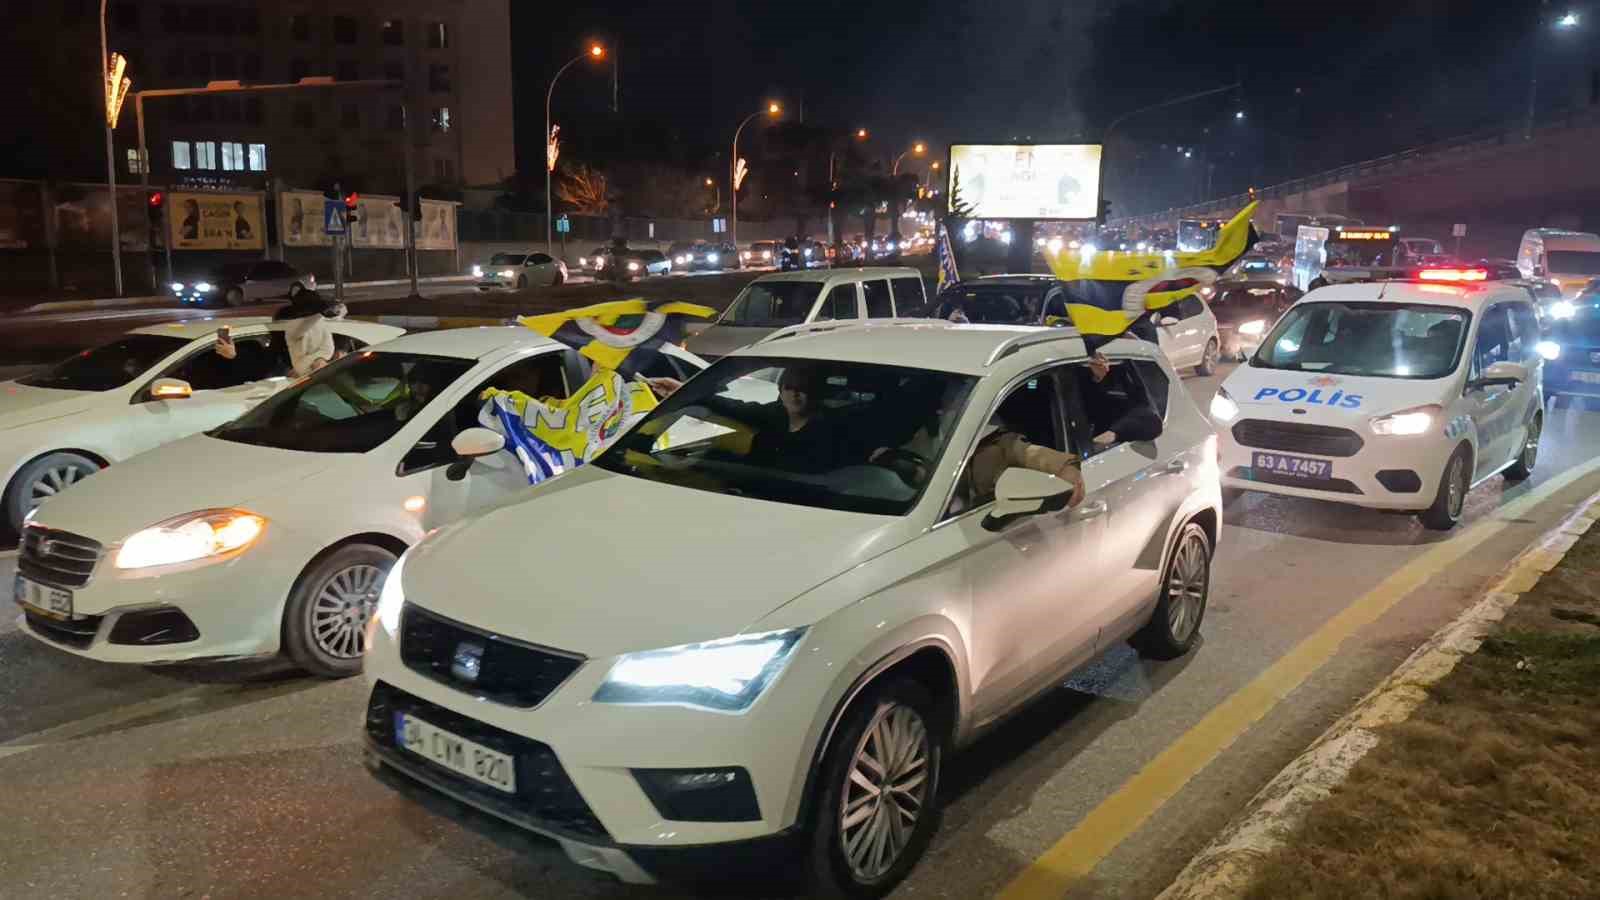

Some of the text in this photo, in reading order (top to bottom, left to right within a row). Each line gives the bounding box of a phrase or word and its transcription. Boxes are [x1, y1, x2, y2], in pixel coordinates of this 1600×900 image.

[1254, 387, 1363, 409] POLİS
[1257, 455, 1274, 469] 63
[1278, 458, 1288, 470] A
[1292, 459, 1326, 475] 7457
